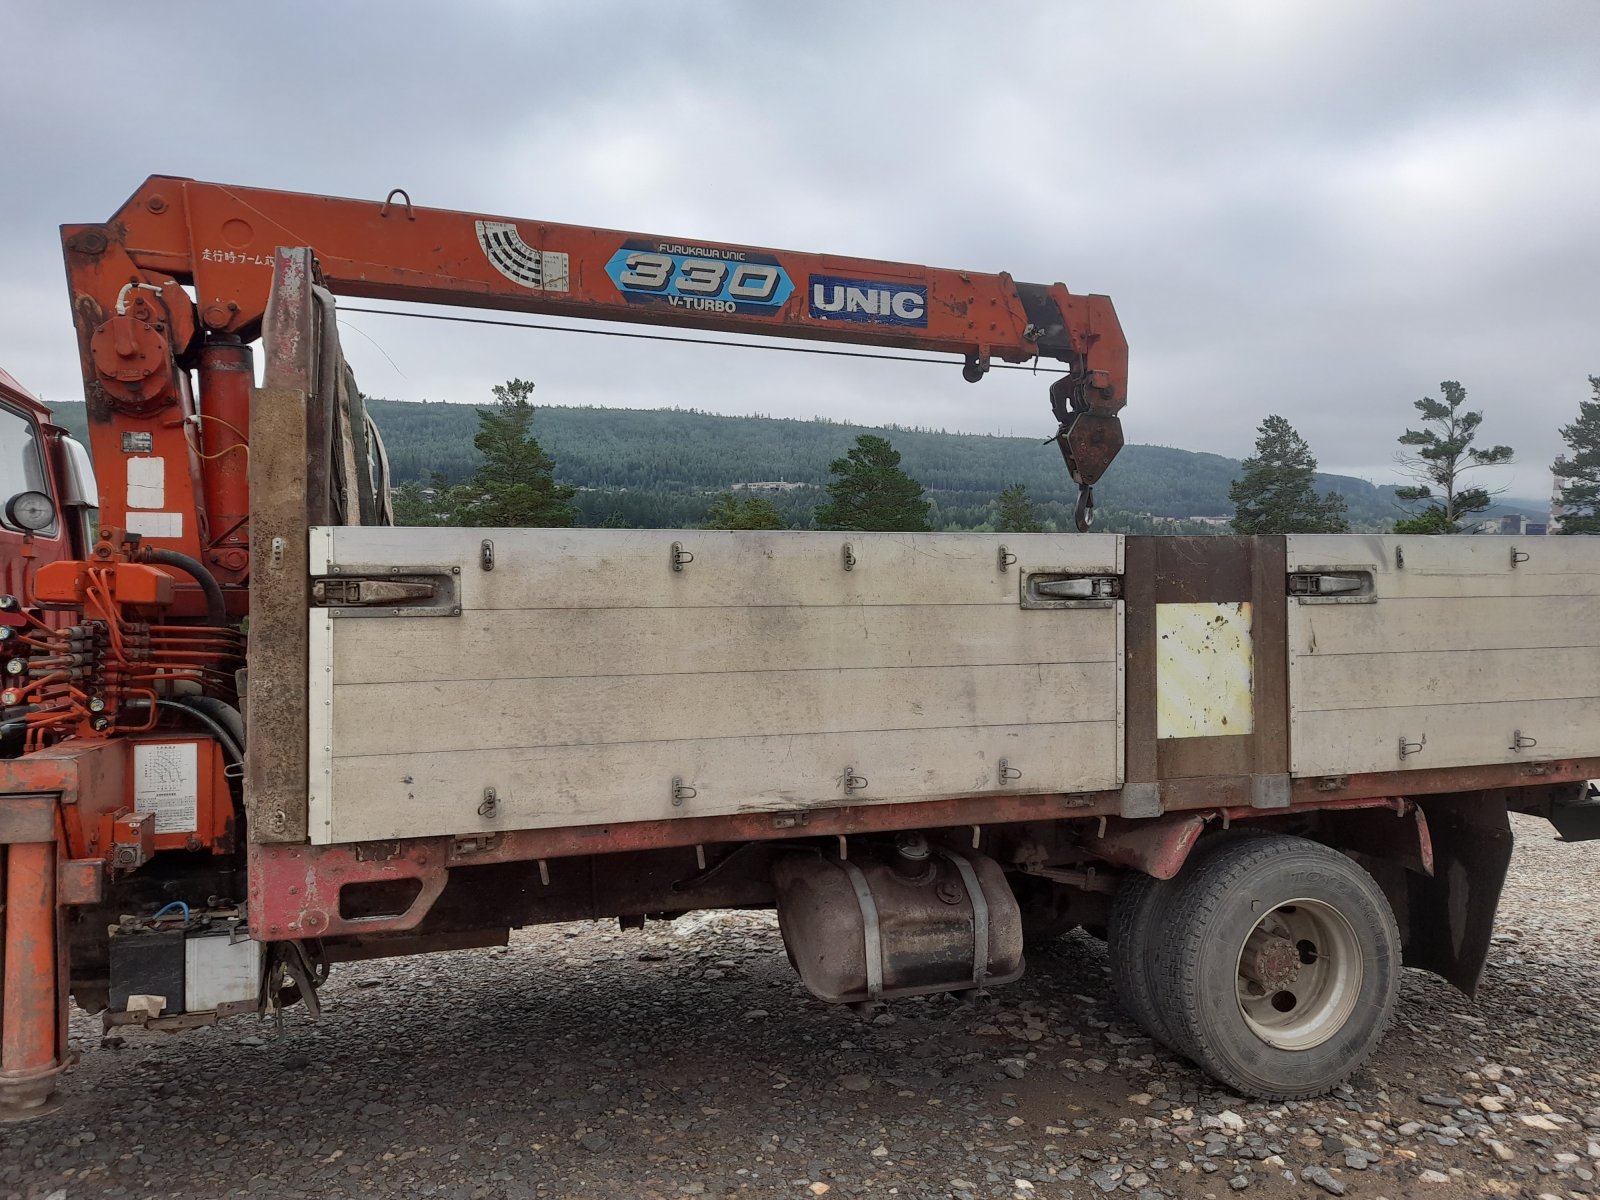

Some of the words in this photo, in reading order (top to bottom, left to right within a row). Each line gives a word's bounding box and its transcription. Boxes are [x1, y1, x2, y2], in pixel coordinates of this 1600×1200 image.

[659, 243, 720, 258] FURUKAWA
[721, 250, 746, 261] UNIC
[619, 252, 780, 302] 330
[667, 295, 736, 313] V-TURBO
[813, 283, 924, 319] UNIC
